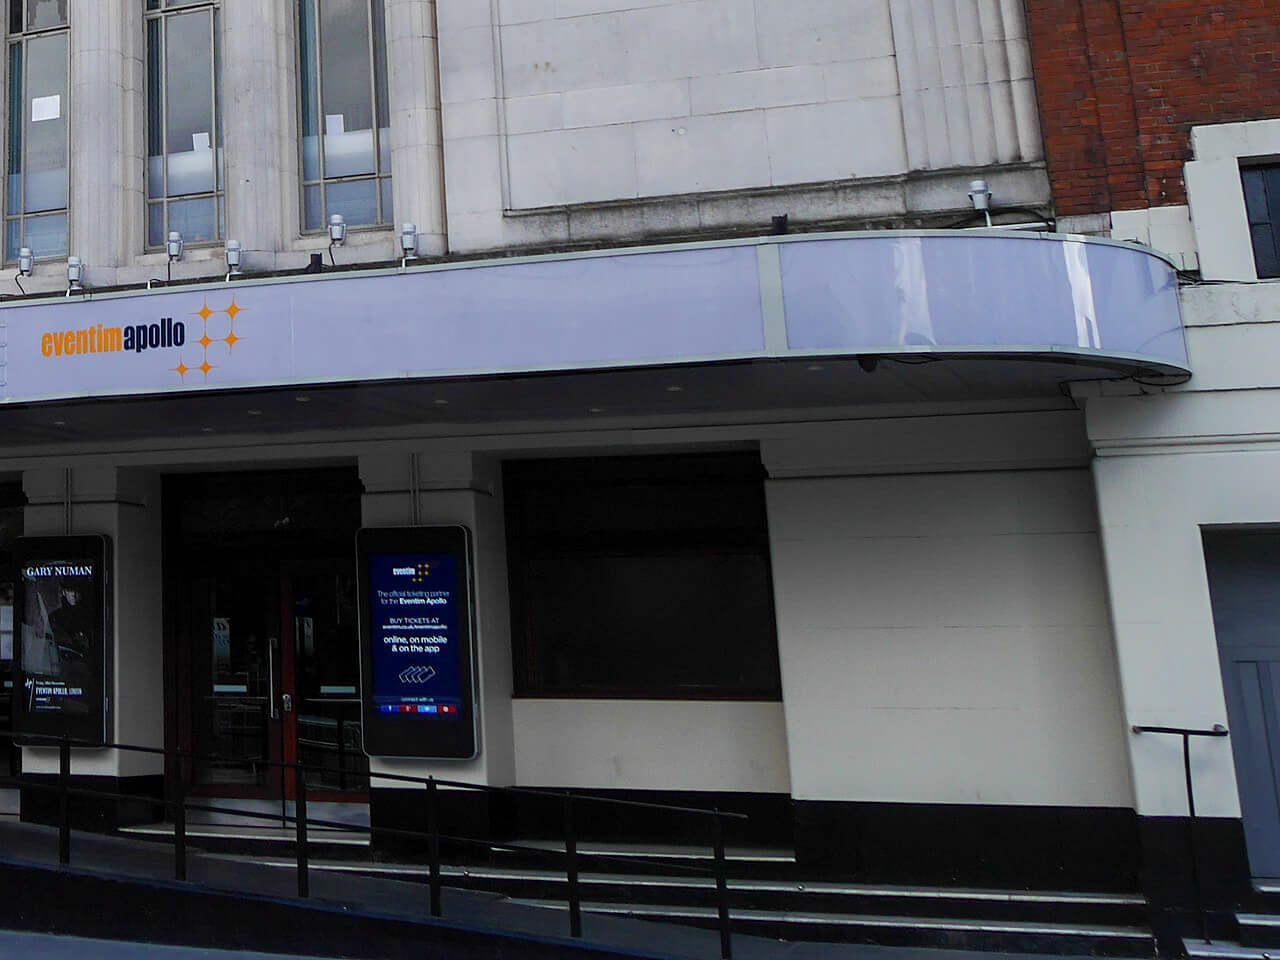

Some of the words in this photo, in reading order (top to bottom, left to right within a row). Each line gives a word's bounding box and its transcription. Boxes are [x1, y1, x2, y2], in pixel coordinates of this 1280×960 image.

[26, 566, 53, 576] GARY
[55, 565, 92, 576] NUMAN
[399, 597, 425, 605] Eventim
[426, 597, 448, 606] Apollo
[383, 635, 409, 644] online,
[409, 636, 420, 644] on
[421, 635, 448, 644] mobile
[391, 644, 398, 652] &
[410, 644, 423, 652] the
[424, 645, 440, 654] app
